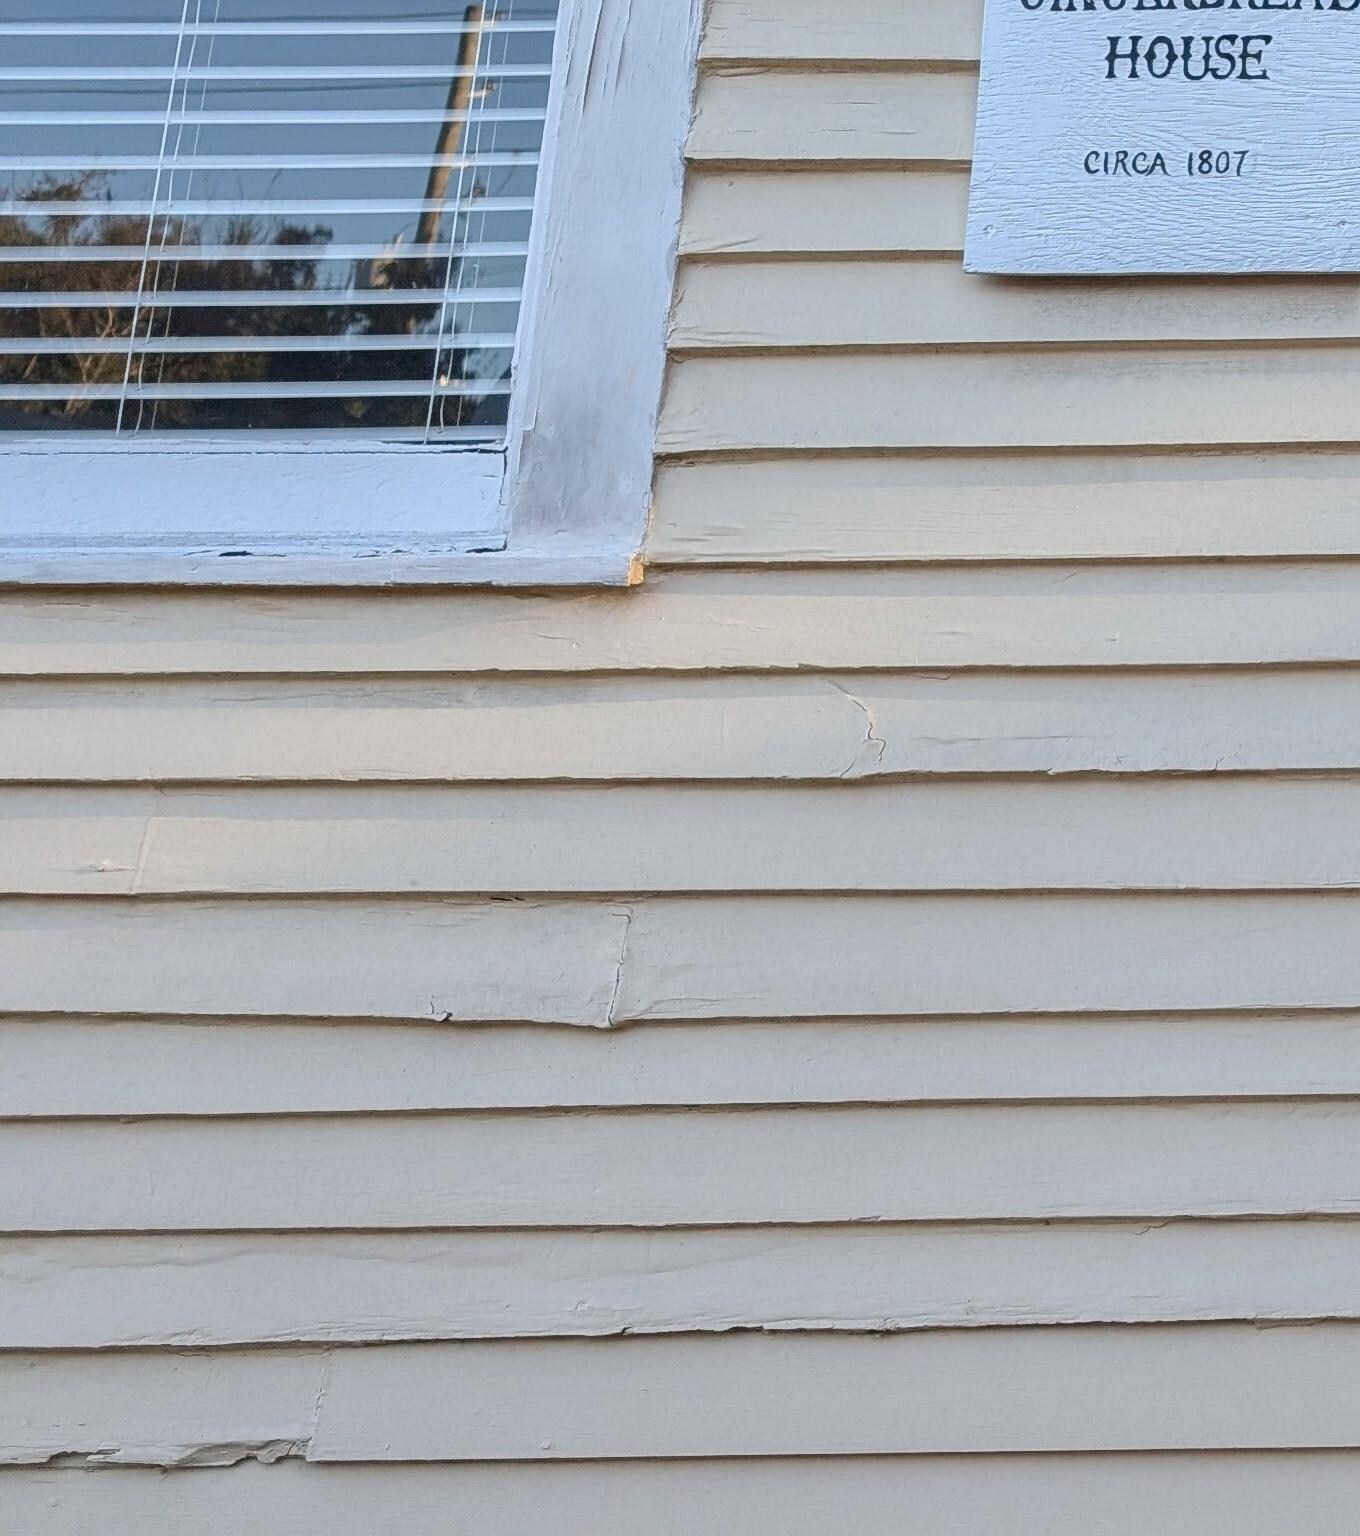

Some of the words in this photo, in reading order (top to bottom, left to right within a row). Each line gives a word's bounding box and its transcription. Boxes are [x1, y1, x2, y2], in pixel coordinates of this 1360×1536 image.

[1104, 33, 1273, 81] HOUSE
[1083, 150, 1170, 177] CIRCA
[1187, 149, 1250, 177] 1807
